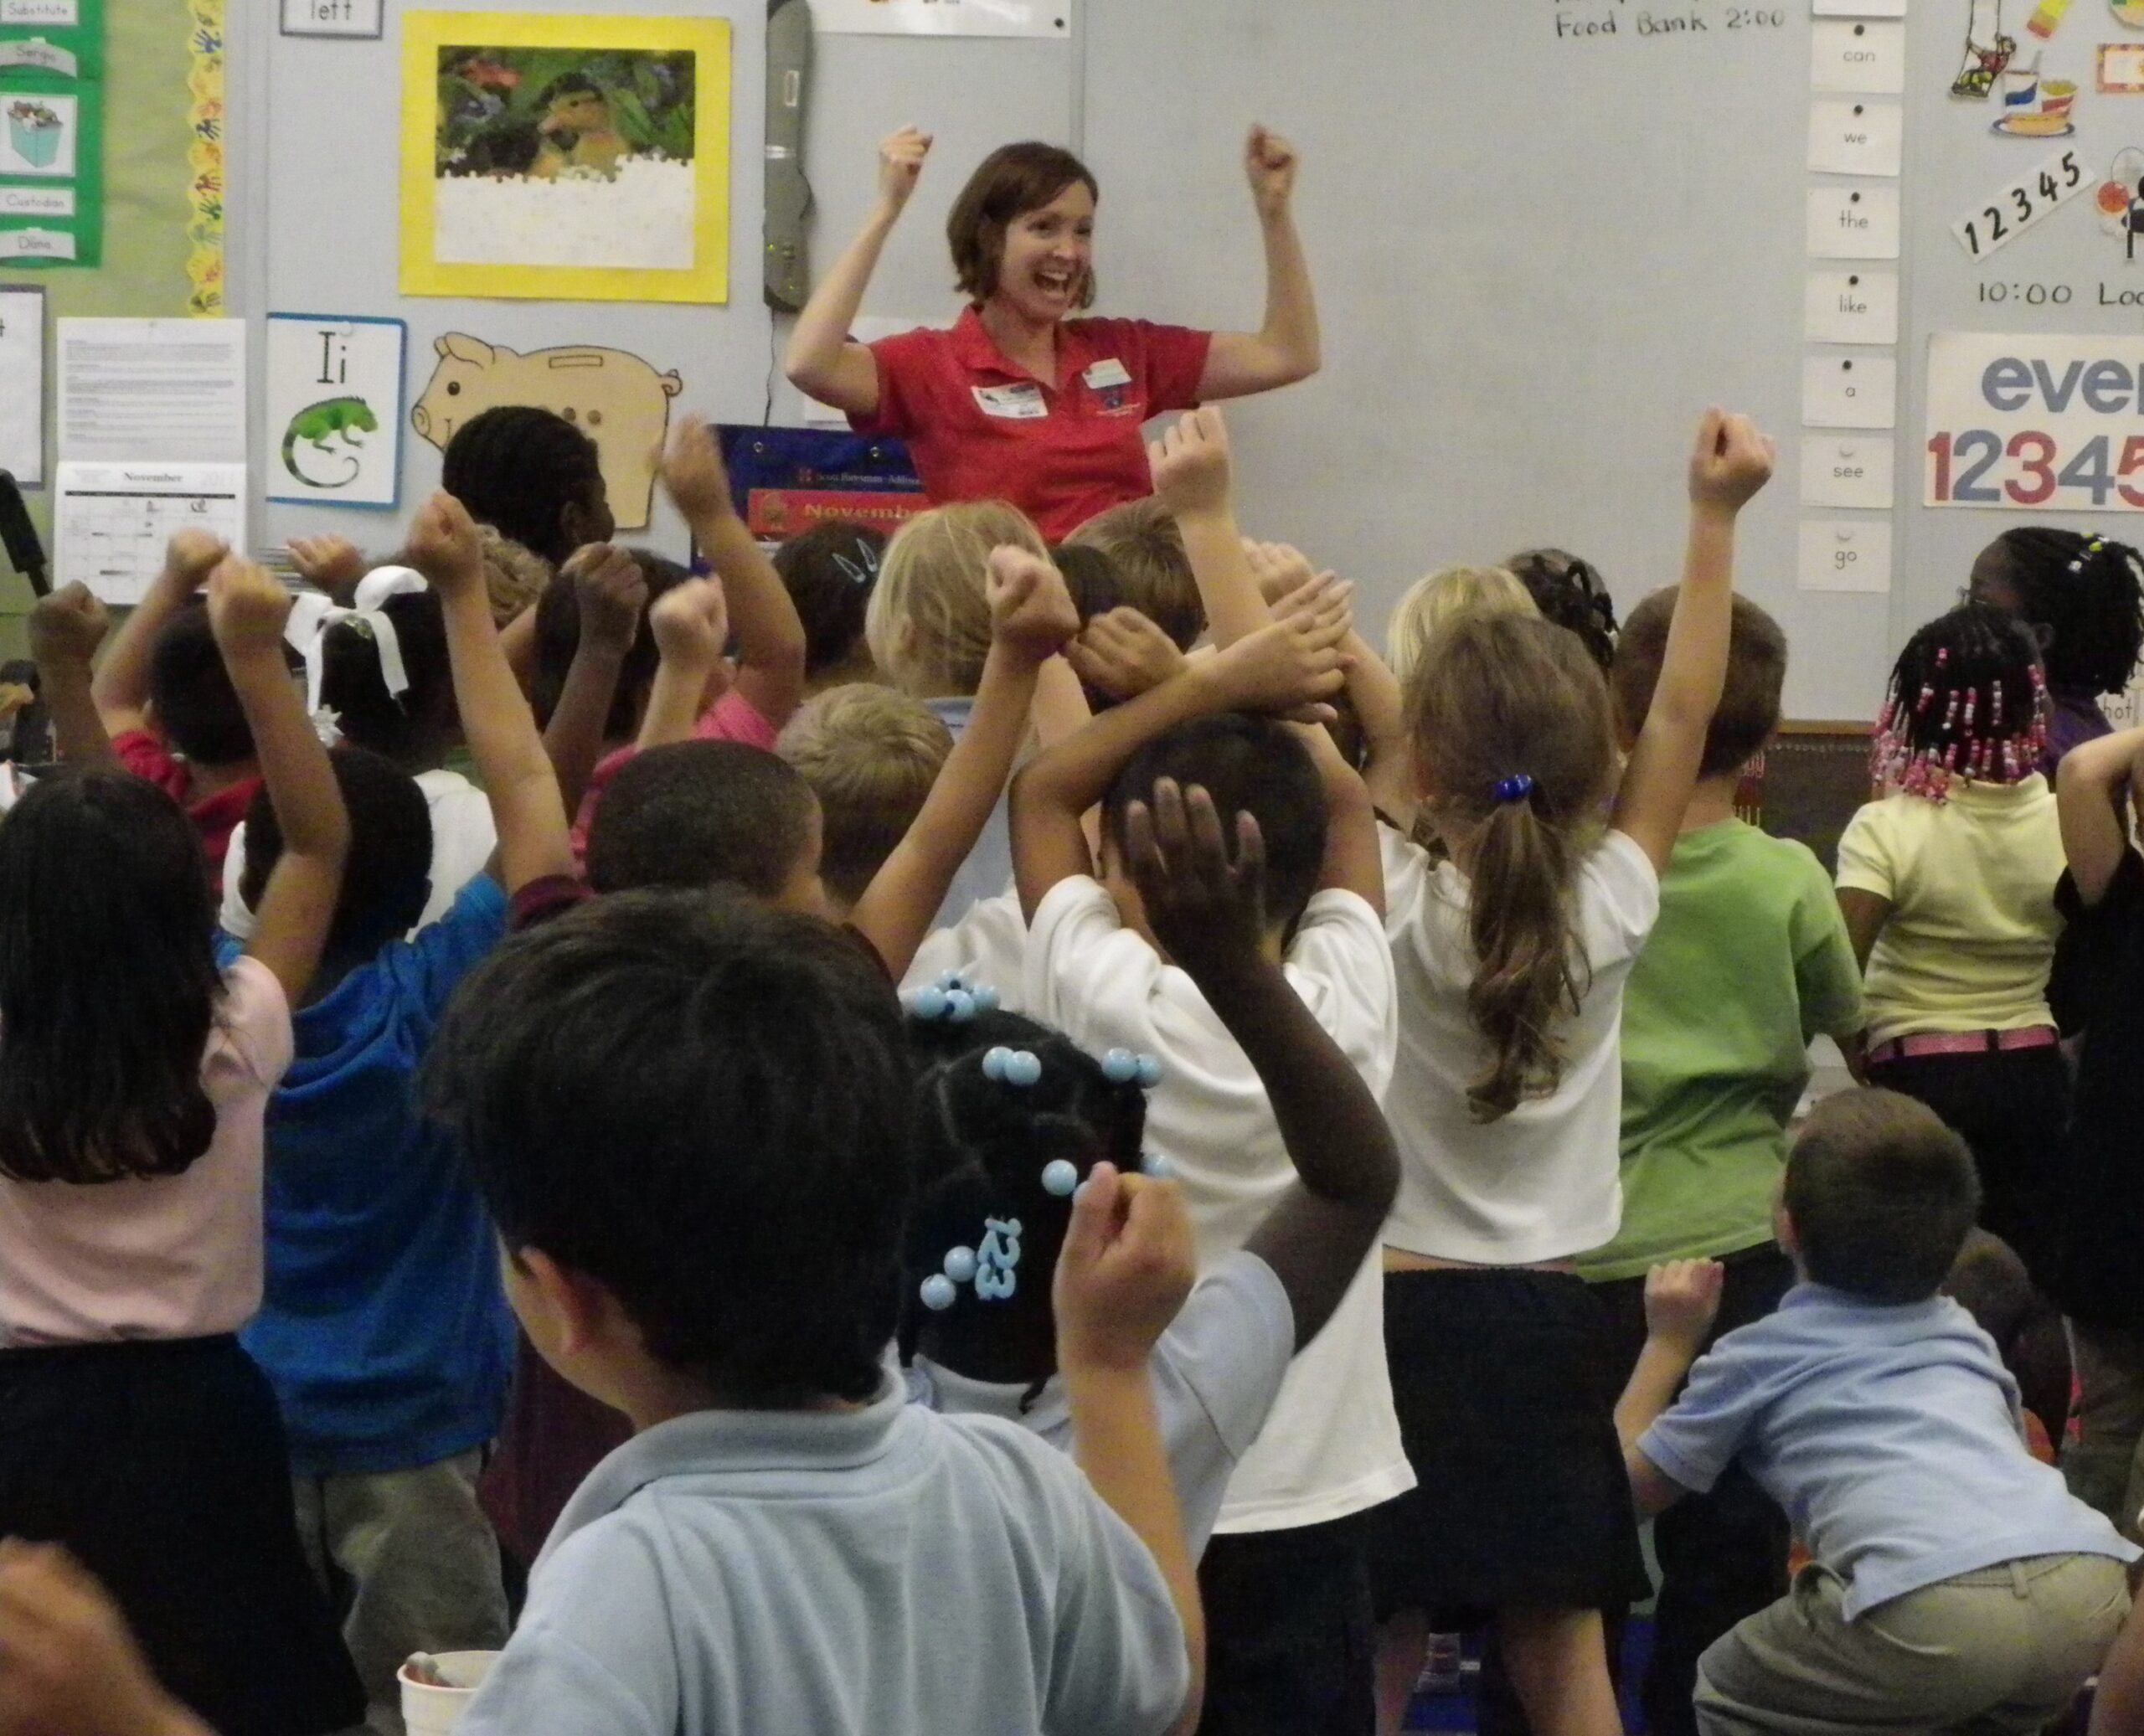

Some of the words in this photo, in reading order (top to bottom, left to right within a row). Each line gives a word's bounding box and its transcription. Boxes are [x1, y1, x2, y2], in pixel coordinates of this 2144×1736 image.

[8, 2, 68, 16] Substitute
[311, 0, 353, 20] left
[1556, 11, 1617, 39] Food
[1636, 9, 1708, 36] Bank
[1725, 8, 1785, 29] 2:00
[1842, 50, 1876, 62] can
[1844, 133, 1868, 145] we
[6, 193, 64, 209] Custodian
[1838, 209, 1868, 229] the
[1980, 281, 2073, 305] 10:00
[1839, 294, 1867, 313] like
[1845, 387, 1856, 397] a
[125, 472, 183, 482] November
[1833, 467, 1863, 477] see
[804, 503, 915, 518] Novemb
[1835, 551, 1858, 570] go
